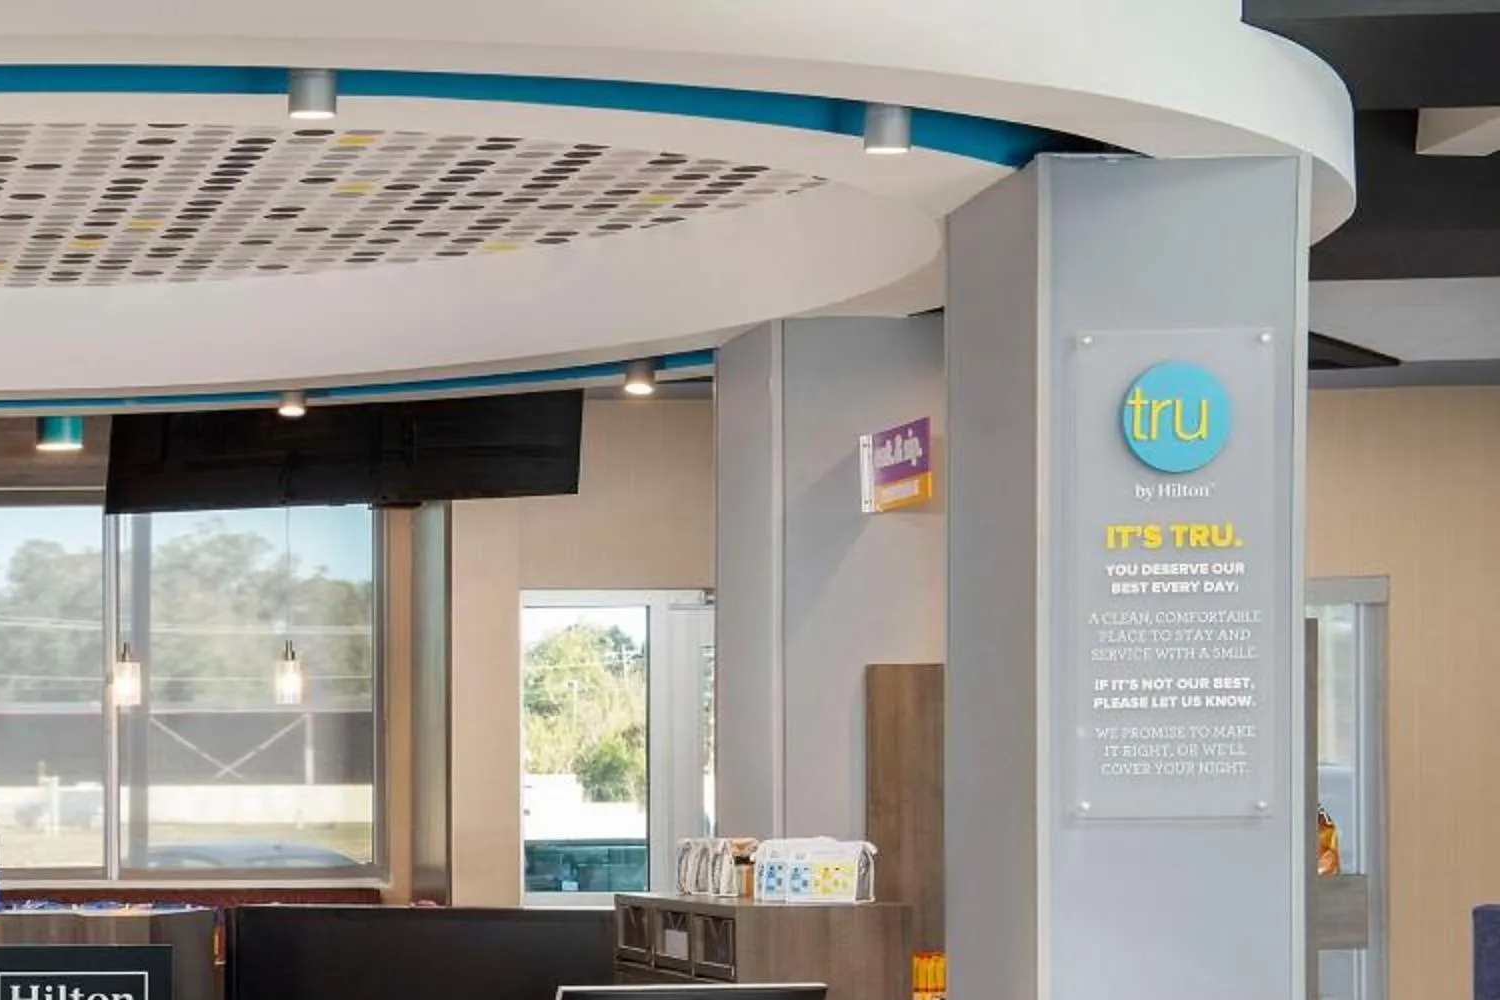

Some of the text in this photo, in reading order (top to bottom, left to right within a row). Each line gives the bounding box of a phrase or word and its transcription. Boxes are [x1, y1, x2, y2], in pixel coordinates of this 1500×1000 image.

[1126, 387, 1208, 443] tru
[1134, 482, 1211, 503] by Hilton
[1105, 523, 1243, 548] IT'S TRU.
[1106, 562, 1245, 577] YOU DESERVE OUR
[1111, 583, 1148, 594] BEST
[1151, 581, 1200, 594] EVERY
[1088, 614, 1099, 625] A
[1155, 609, 1263, 624] COMFORTABLE
[1099, 629, 1251, 643] PLACE TO STAY AND
[1091, 648, 1152, 661] SERVICE
[1155, 648, 1195, 660] WITH
[1198, 647, 1211, 660] A
[1094, 679, 1109, 691] IF
[1111, 678, 1139, 691] IT'S
[1141, 678, 1173, 691] NOT
[1176, 677, 1210, 690] OUR
[1093, 697, 1149, 709] PLEASE
[1151, 696, 1178, 709] LET
[1181, 696, 1202, 708] US
[1096, 725, 1257, 739] WE PROMISE TO MAKE
[1103, 745, 1120, 757] IT
[1177, 743, 1199, 757] OR
[1101, 762, 1153, 775] COVER
[1154, 761, 1196, 775] YOUR
